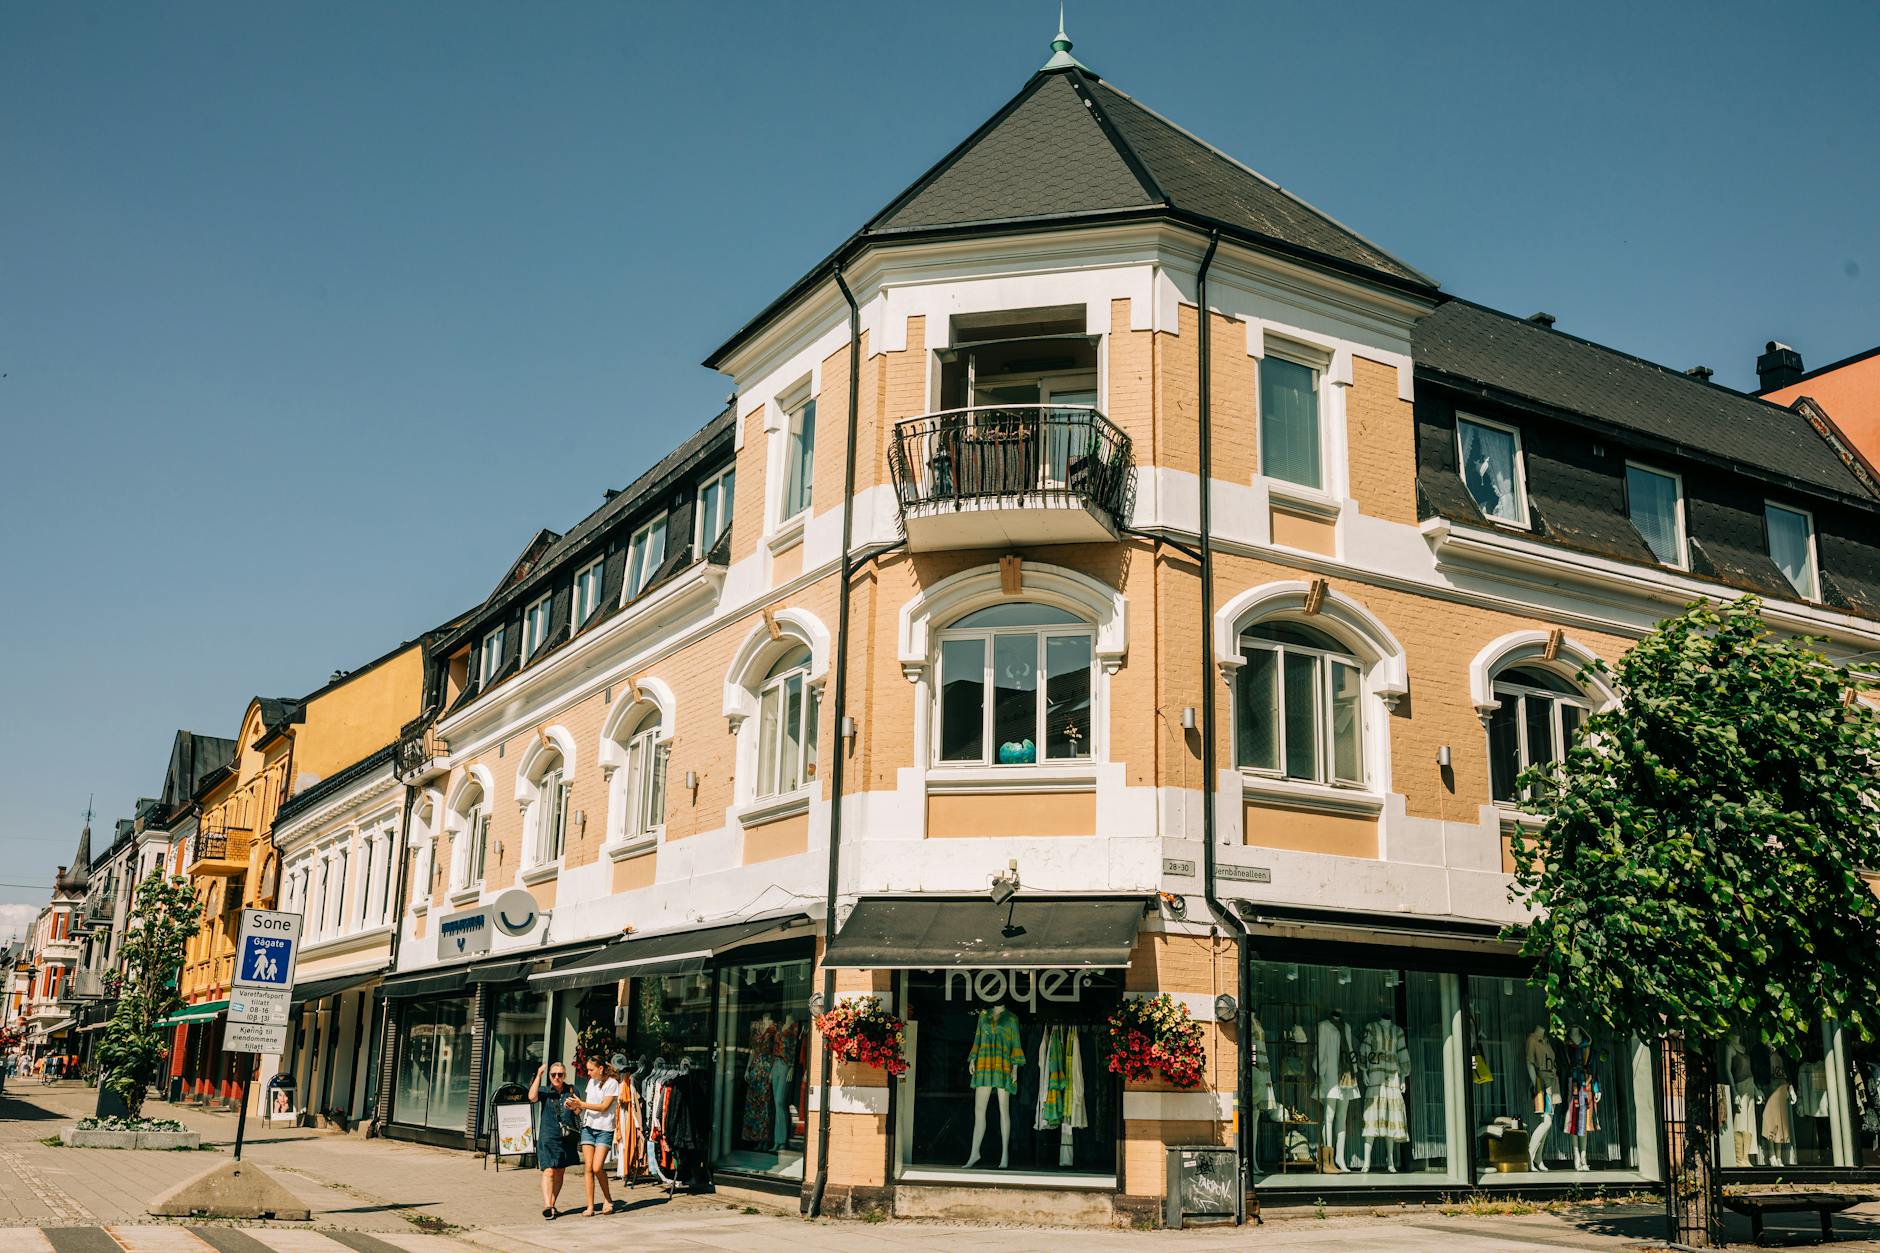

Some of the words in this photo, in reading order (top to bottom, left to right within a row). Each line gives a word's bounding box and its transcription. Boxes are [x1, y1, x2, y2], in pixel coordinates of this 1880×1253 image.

[1216, 867, 1267, 879] ernbanealleen
[253, 914, 291, 931] Sone
[254, 937, 284, 948] Gågate
[239, 990, 284, 999] Varetransport
[240, 1026, 263, 1035] Kjøring
[232, 1034, 278, 1043] eiendommene
